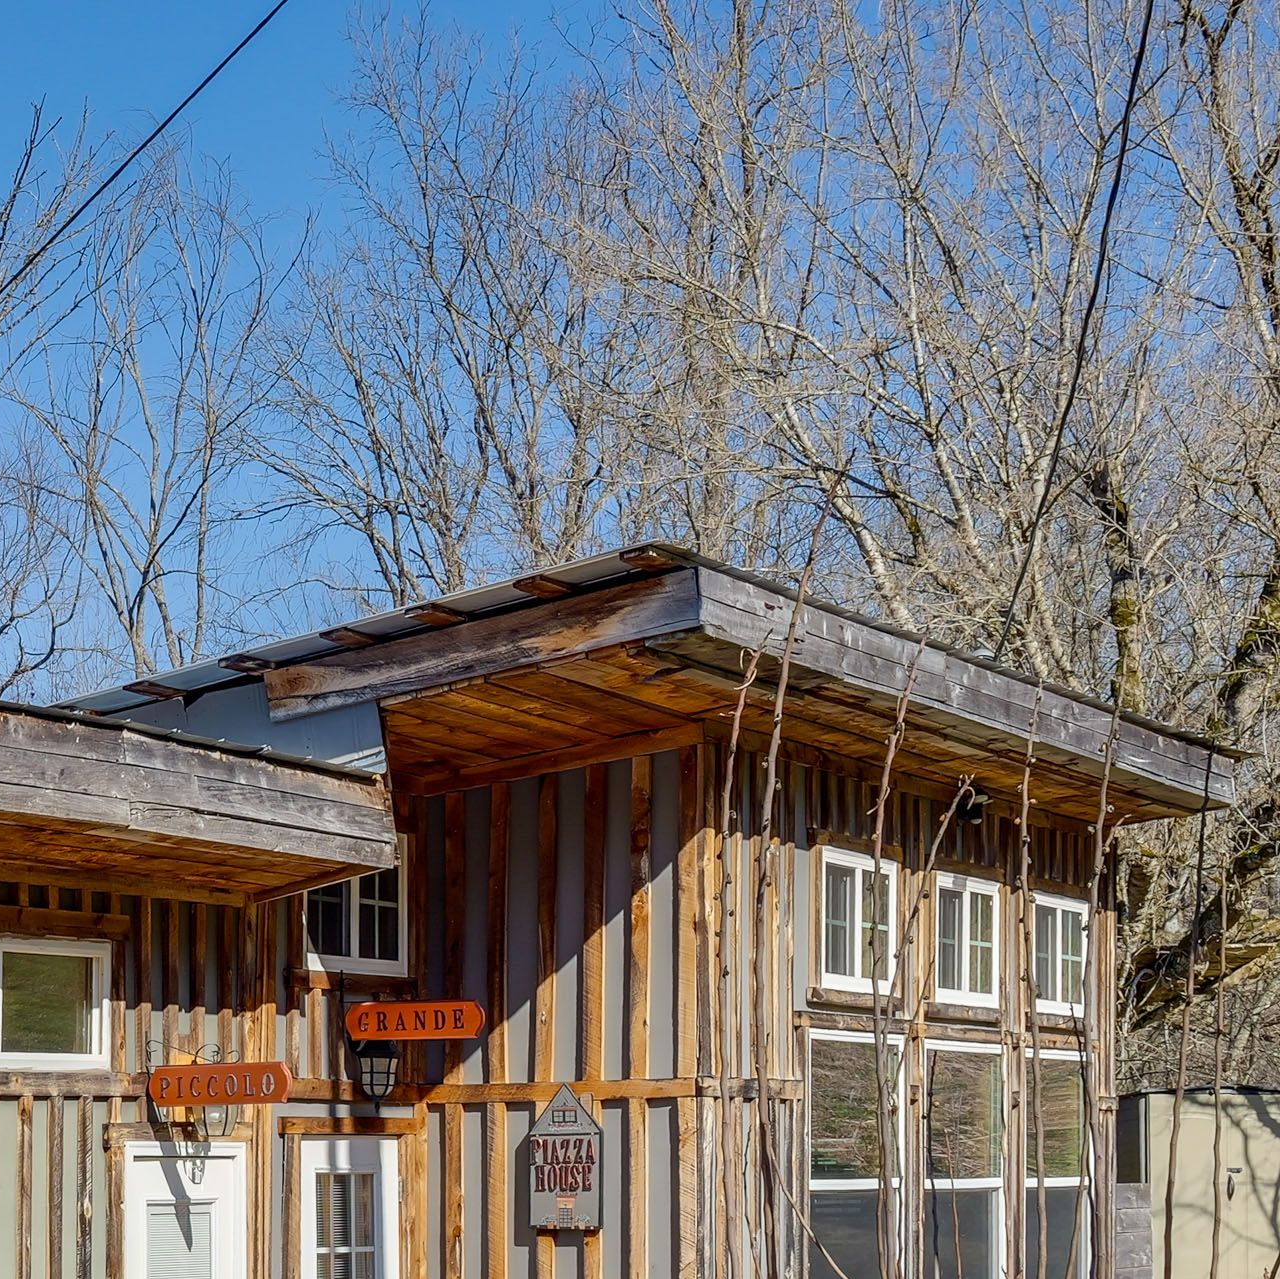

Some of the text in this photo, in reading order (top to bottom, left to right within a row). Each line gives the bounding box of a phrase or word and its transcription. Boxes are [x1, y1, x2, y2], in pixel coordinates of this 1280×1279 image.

[357, 1008, 465, 1033] GRANDE
[159, 1071, 276, 1100] PICCOLO
[530, 1137, 596, 1166] PIAZZA
[533, 1163, 594, 1194] HOUSE
